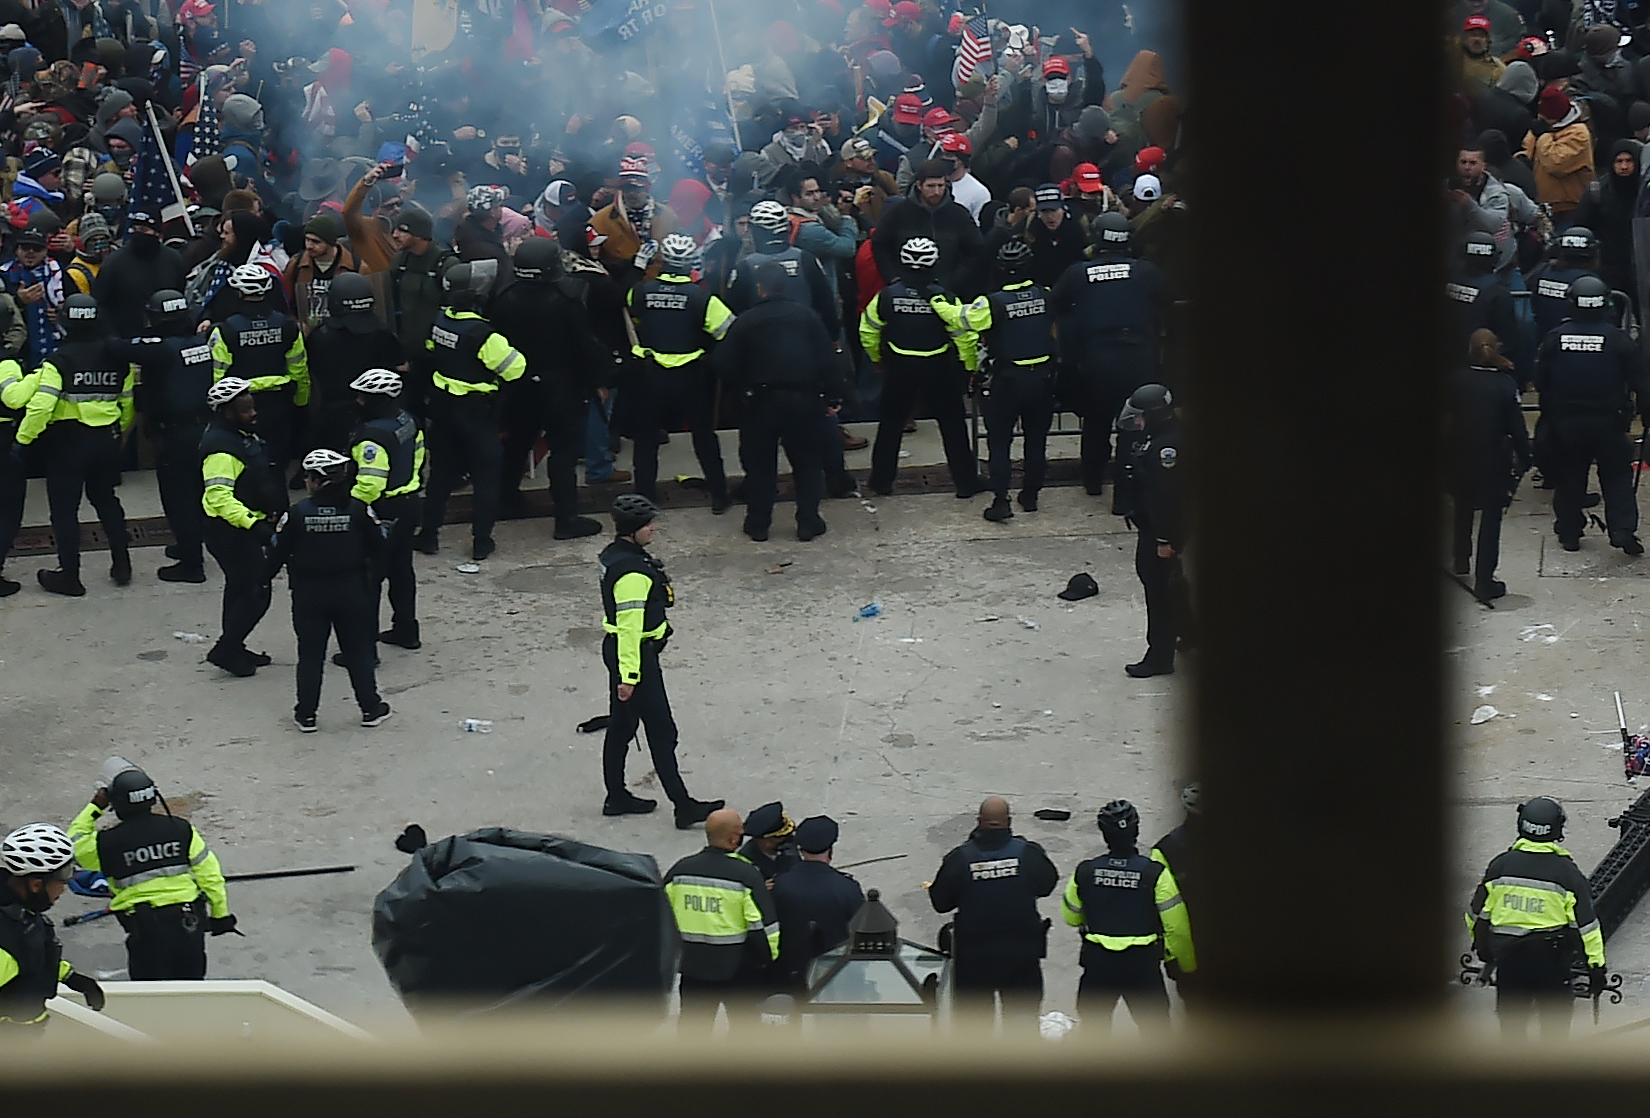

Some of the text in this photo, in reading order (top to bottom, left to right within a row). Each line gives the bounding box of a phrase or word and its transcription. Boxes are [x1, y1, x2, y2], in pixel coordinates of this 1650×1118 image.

[1103, 230, 1130, 241] MPDC
[1089, 270, 1130, 282] POLICE
[1539, 287, 1565, 298] POLICE
[646, 301, 686, 309] POLICE
[894, 305, 931, 313] POLICE
[1008, 305, 1046, 318] POLICE
[240, 335, 282, 346] POLICE
[1562, 342, 1603, 351] POLICE
[184, 352, 211, 365] POLICE
[74, 372, 117, 385] POLICE
[306, 524, 349, 532] POLICE
[1523, 820, 1551, 835] MPDC
[124, 842, 181, 866] POLICE
[973, 867, 1019, 880] POLICE
[1094, 869, 1140, 880] METROPOLITAN
[1095, 877, 1138, 888] POLICE
[685, 895, 722, 914] POLICE
[1503, 894, 1544, 913] POLICE
